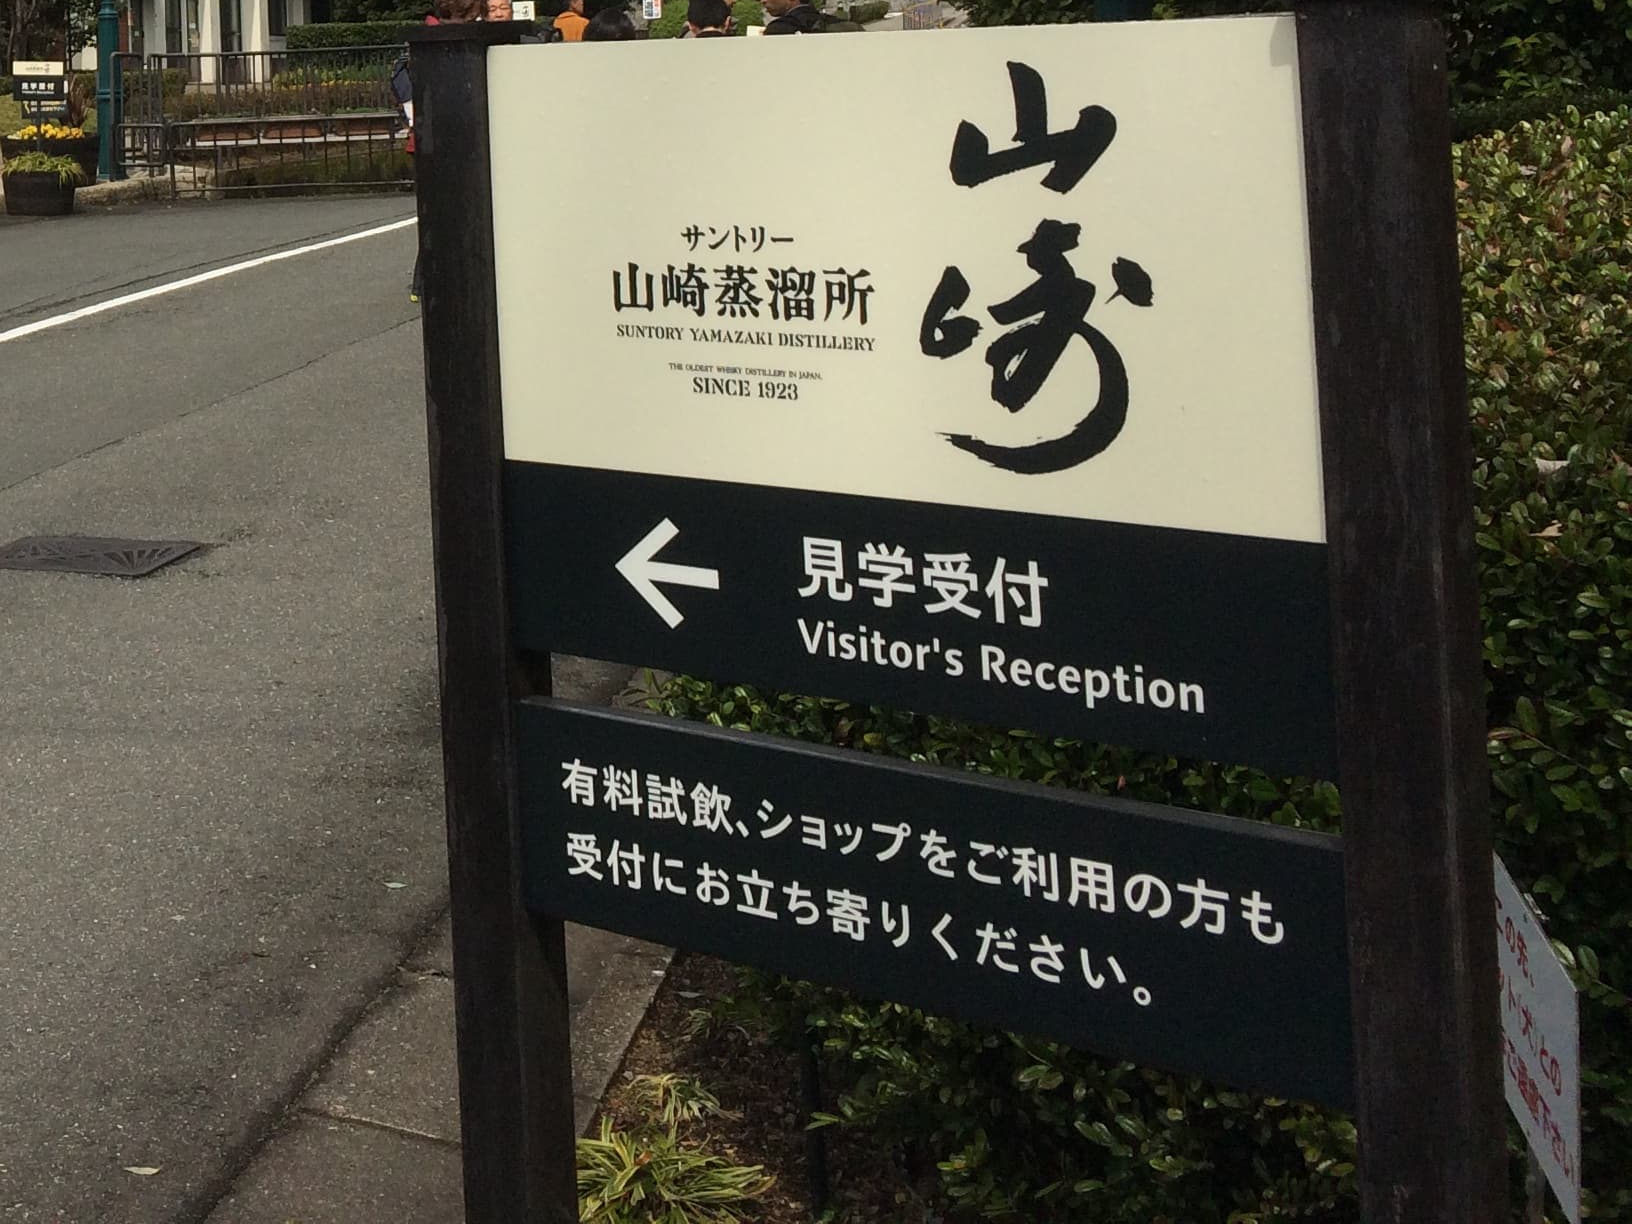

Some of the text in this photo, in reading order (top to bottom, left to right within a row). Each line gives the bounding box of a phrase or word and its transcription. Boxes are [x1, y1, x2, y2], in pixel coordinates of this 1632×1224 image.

[681, 224, 794, 253] サントリー
[920, 61, 1154, 476] 山崎
[612, 262, 875, 325] 山崎蒸溜所
[616, 324, 876, 352] SUNTORY YAMAZAKI DISTILLERY
[668, 362, 683, 371] THE
[685, 363, 713, 373] OLDEST
[744, 367, 786, 378] DISTILLERY
[788, 370, 798, 378] IN
[692, 376, 799, 401] SINCE 1923
[797, 536, 1049, 628] 見学受付
[797, 618, 1206, 714] Visitor's Reception
[561, 758, 1286, 945] 有料試飲、ショップをご利用の方も
[566, 832, 1153, 1007] 受付にお立ち寄りください。
